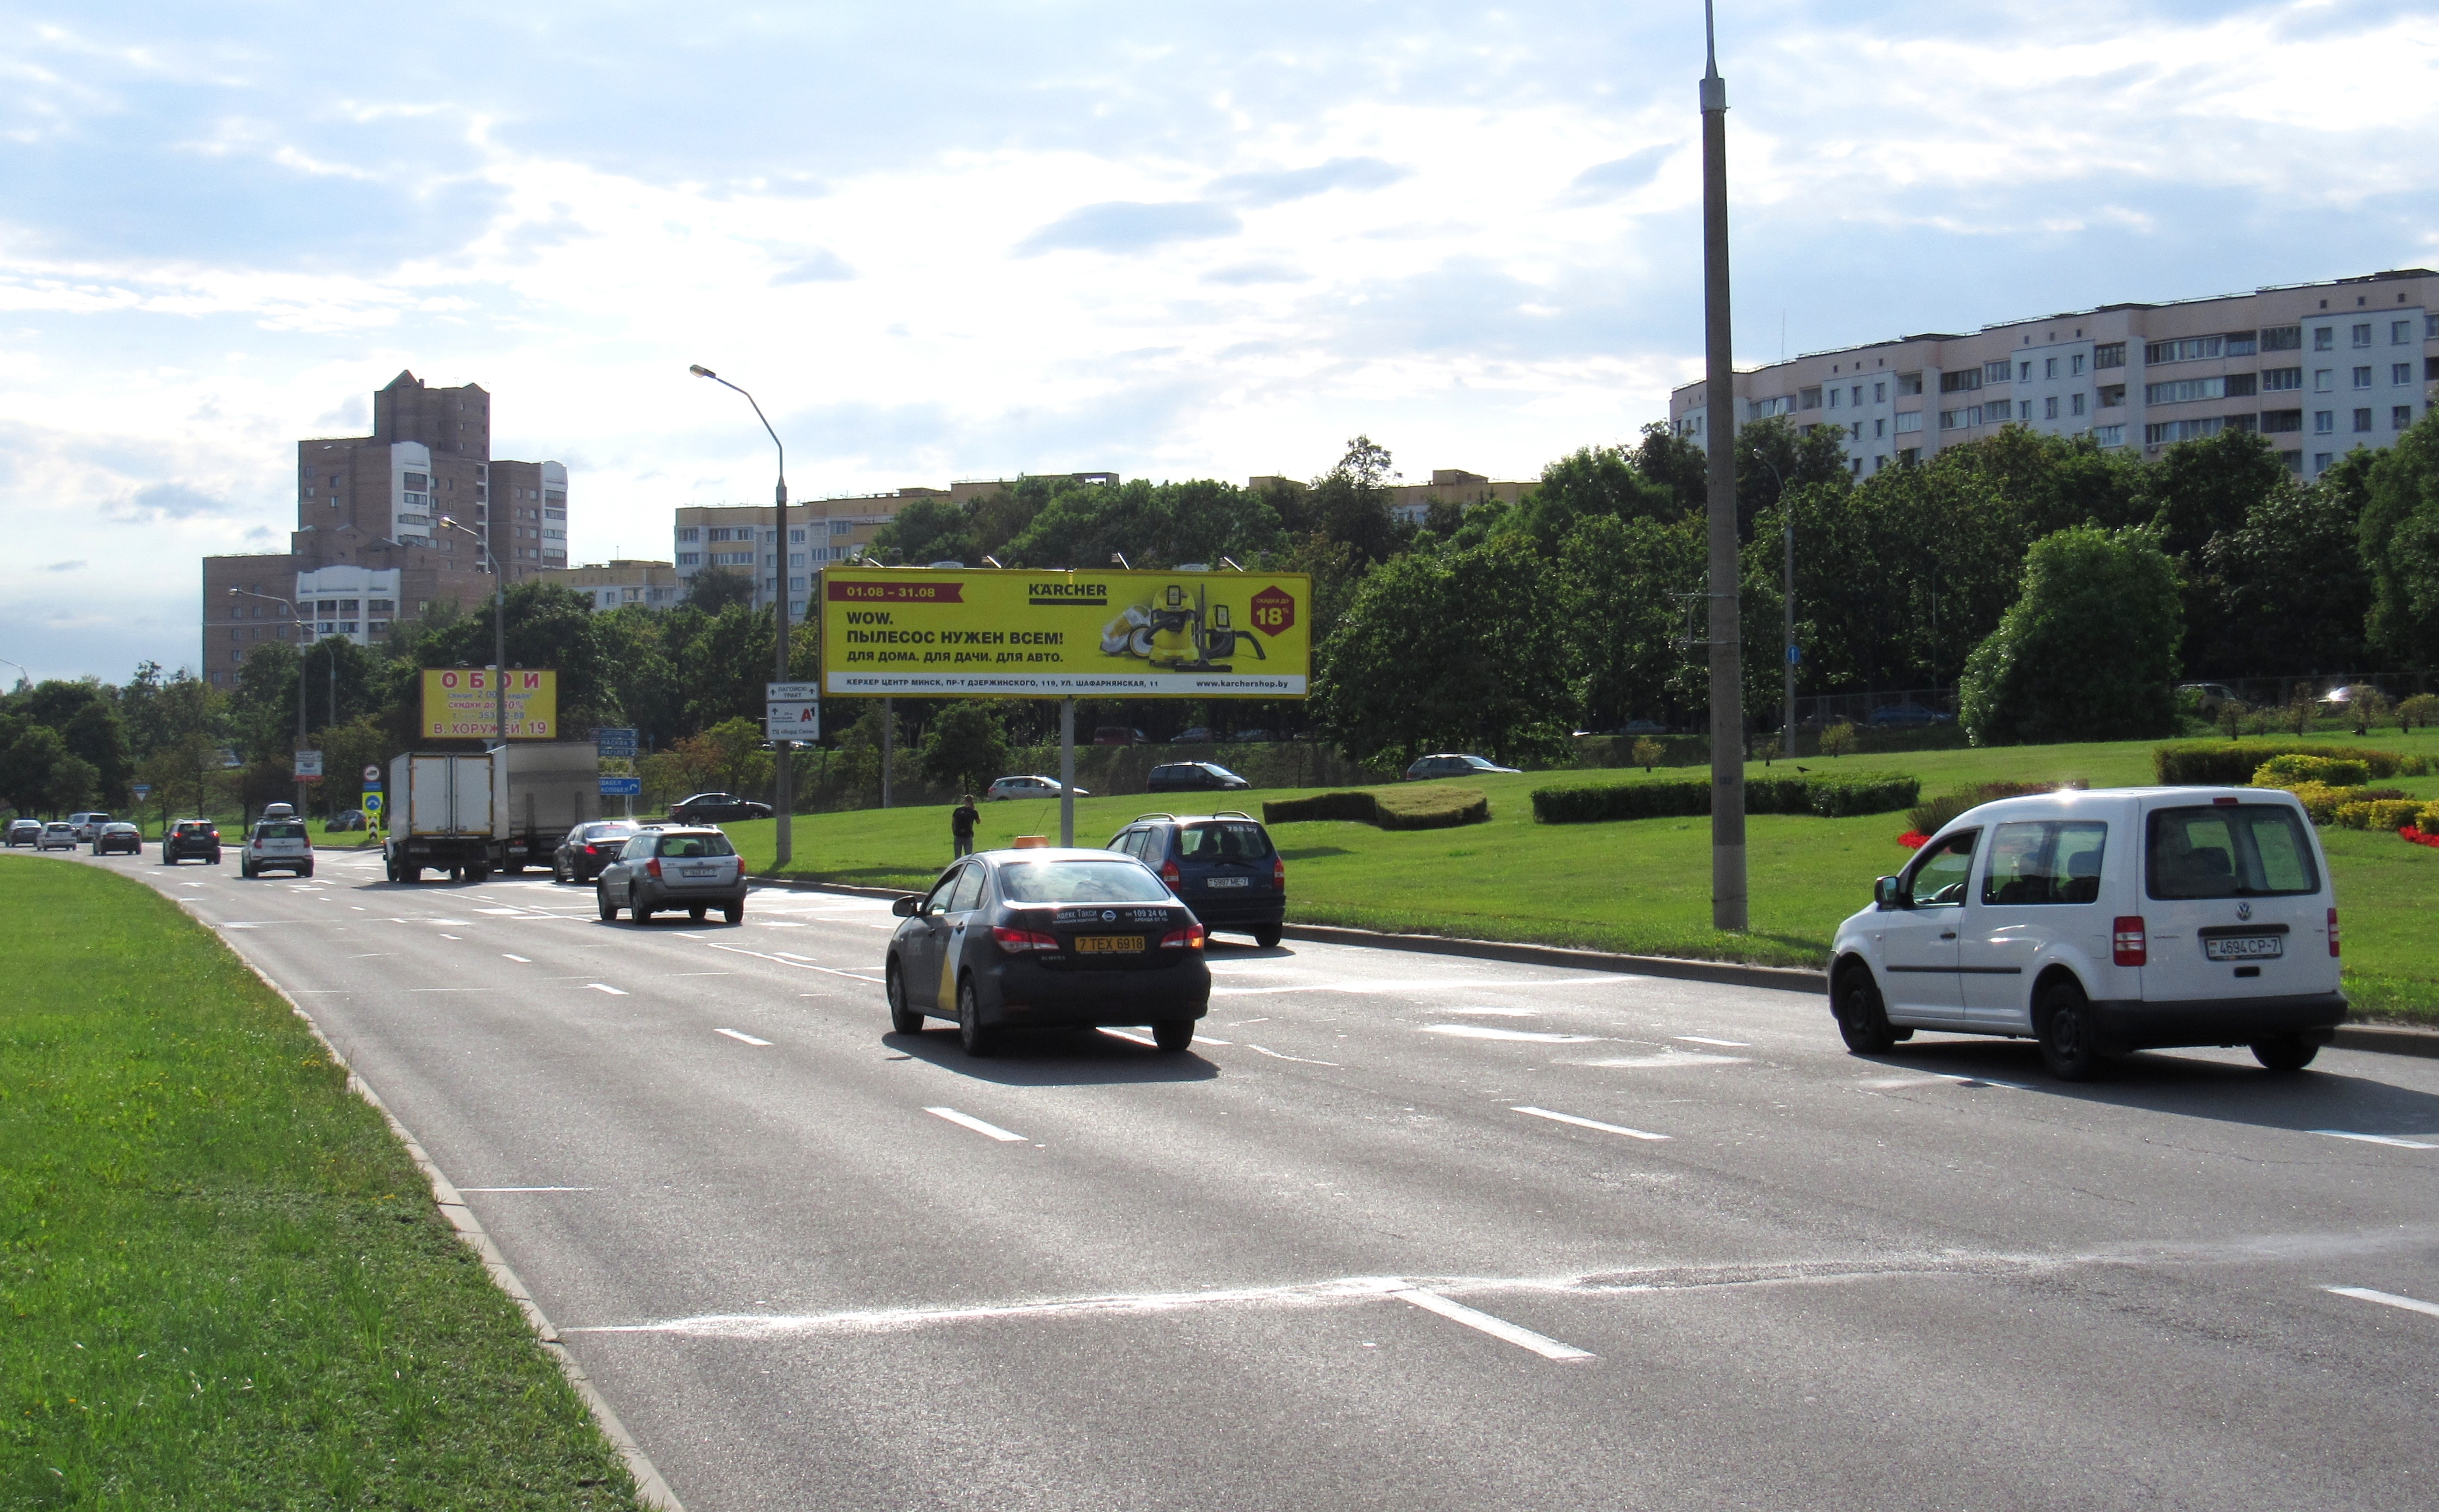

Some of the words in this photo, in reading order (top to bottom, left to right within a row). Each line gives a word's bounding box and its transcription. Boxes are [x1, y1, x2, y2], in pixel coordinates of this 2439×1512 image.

[847, 587, 884, 597] 01.08
[898, 587, 936, 598] 31.08
[1029, 583, 1107, 596] KÄRCHER
[846, 611, 894, 625] WOW.
[847, 630, 935, 644] ПЫЛЕСОС
[941, 631, 1004, 645] НУЖЕН
[1009, 632, 1064, 645] ВСЕМ!
[847, 651, 875, 663] ДЛЯ
[878, 652, 920, 663] ДОМА.
[924, 652, 951, 664] ДЛЯ
[955, 652, 992, 664] ДАЧИ.
[996, 652, 1023, 664] ДЛЯ
[1026, 652, 1064, 663] АВТО.
[882, 679, 909, 687] ЦЕНТР
[911, 679, 944, 687] МИНСК,
[967, 679, 1039, 688] ДЗЕРЖИНСКОГО,
[1041, 680, 1058, 688] 119,
[1075, 680, 1147, 688] ШАФАРНЯНСКАЯ,
[1196, 680, 1288, 689] www.karchershop.by
[448, 701, 481, 709] скидки
[434, 723, 447, 734] В.
[528, 722, 547, 734] 19
[1077, 909, 1098, 918] Такси
[1080, 938, 1086, 950] 7
[1090, 938, 1113, 950] TEX
[1117, 937, 1144, 950] 6918
[2220, 940, 2248, 954] 4694
[2248, 939, 2278, 953] CP-7
